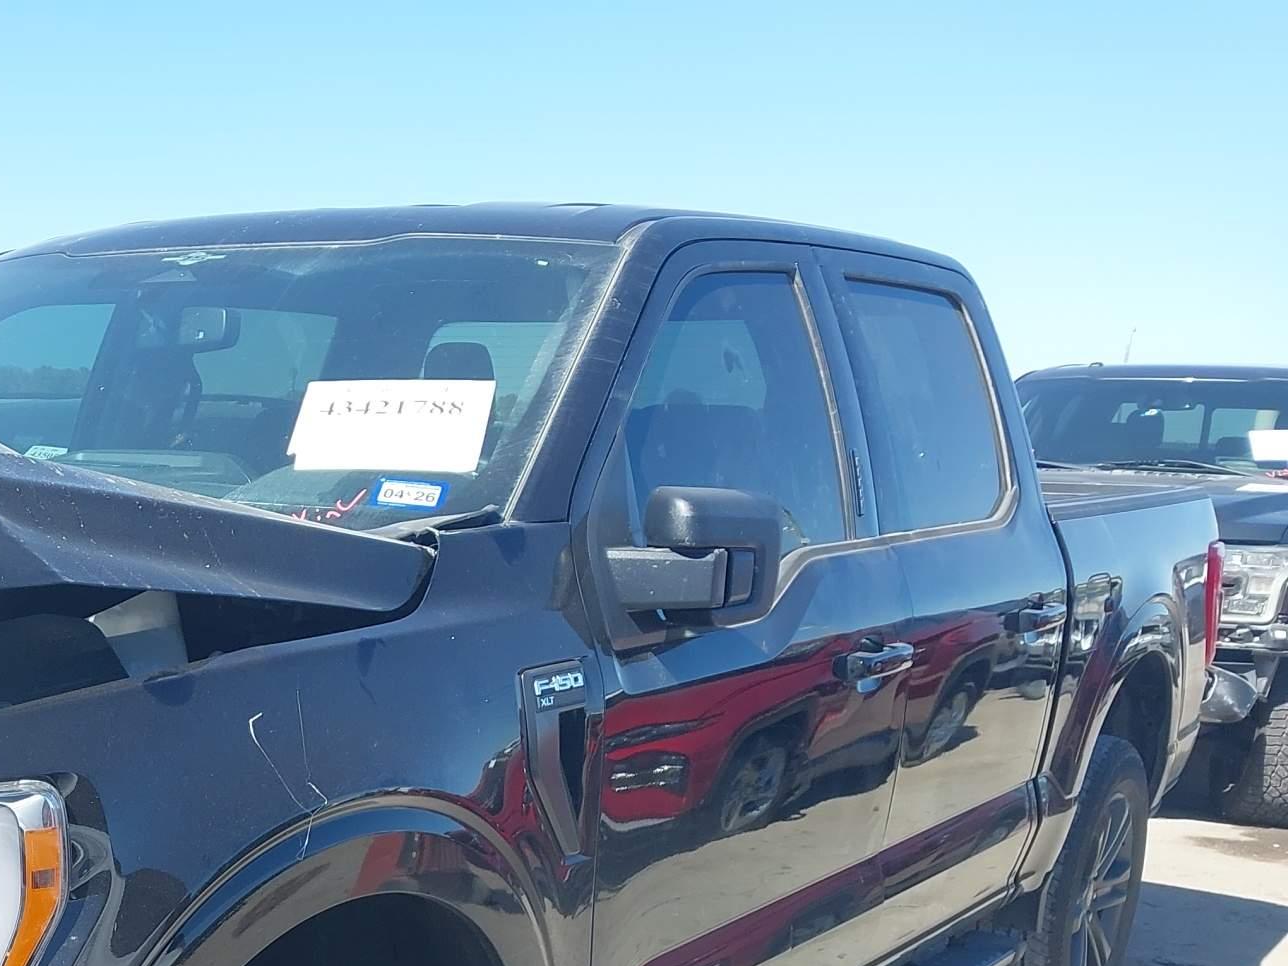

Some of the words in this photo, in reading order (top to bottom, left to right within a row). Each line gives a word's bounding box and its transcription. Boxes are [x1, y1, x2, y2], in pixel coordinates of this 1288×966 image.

[320, 400, 465, 416] 43421788
[383, 488, 404, 499] 04
[413, 490, 437, 503] 26
[541, 696, 554, 707] XLT
